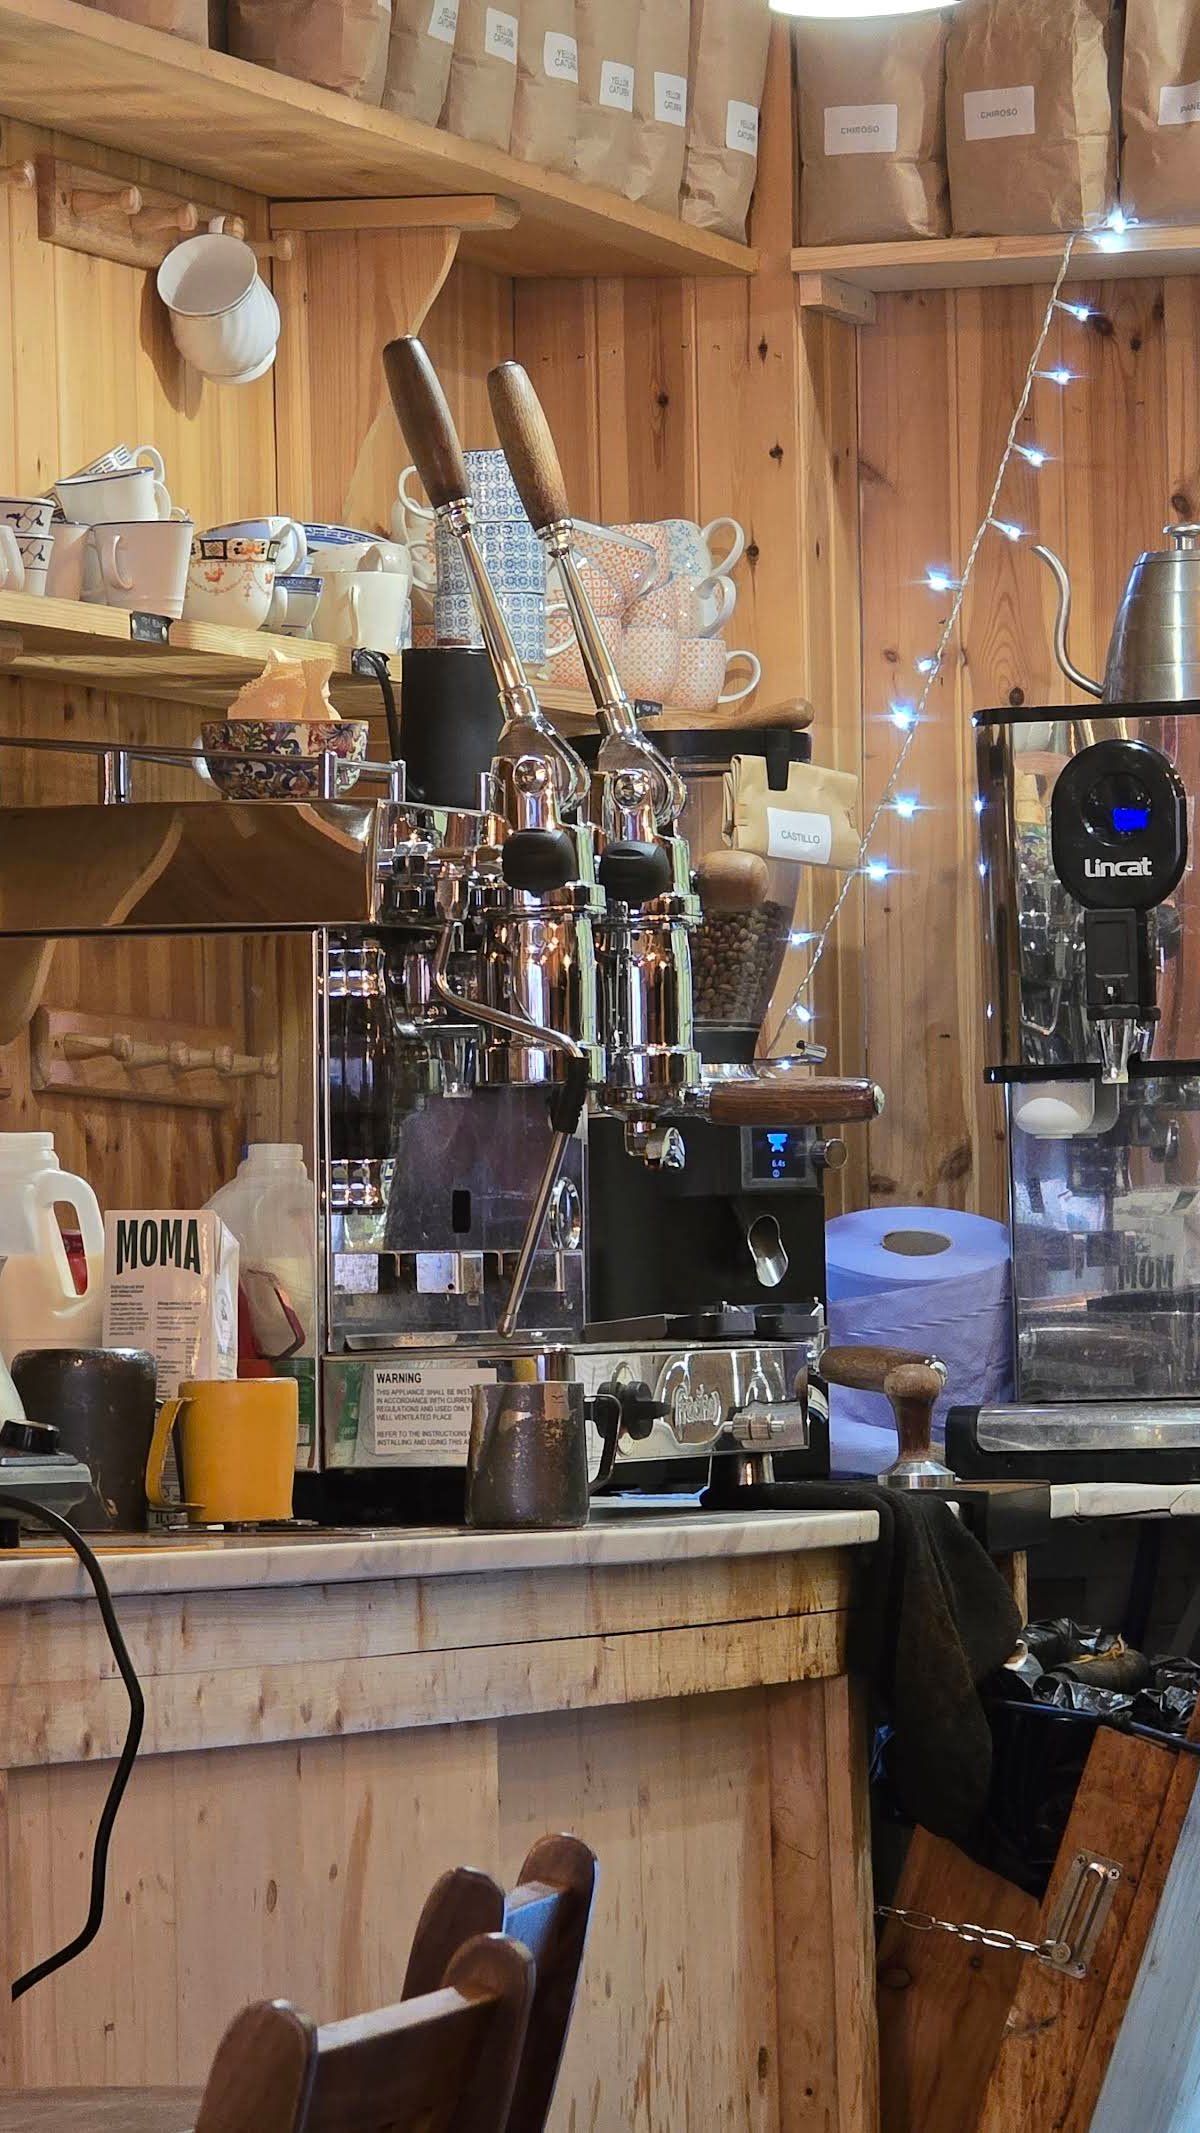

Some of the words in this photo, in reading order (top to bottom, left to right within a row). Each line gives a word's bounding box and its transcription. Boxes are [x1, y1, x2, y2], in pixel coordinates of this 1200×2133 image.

[980, 108, 1018, 119] CHIROSO
[840, 125, 880, 135] CHIROSO
[781, 830, 821, 844] CASTILLO
[116, 1219, 201, 1275] MOMA
[376, 1372, 422, 1384] WARNING
[376, 1388, 390, 1396] THIS
[391, 1388, 424, 1396] APPLIANCE
[426, 1388, 445, 1396] SHALL
[446, 1388, 455, 1396] BE
[376, 1430, 398, 1438] REFER
[398, 1430, 408, 1438] TO
[408, 1430, 420, 1438] THE
[421, 1430, 467, 1438] INSTRUCTIONS
[377, 1439, 412, 1447] INSTALLING
[413, 1439, 427, 1447] AND
[427, 1439, 447, 1447] USING
[448, 1439, 463, 1447] THIS
